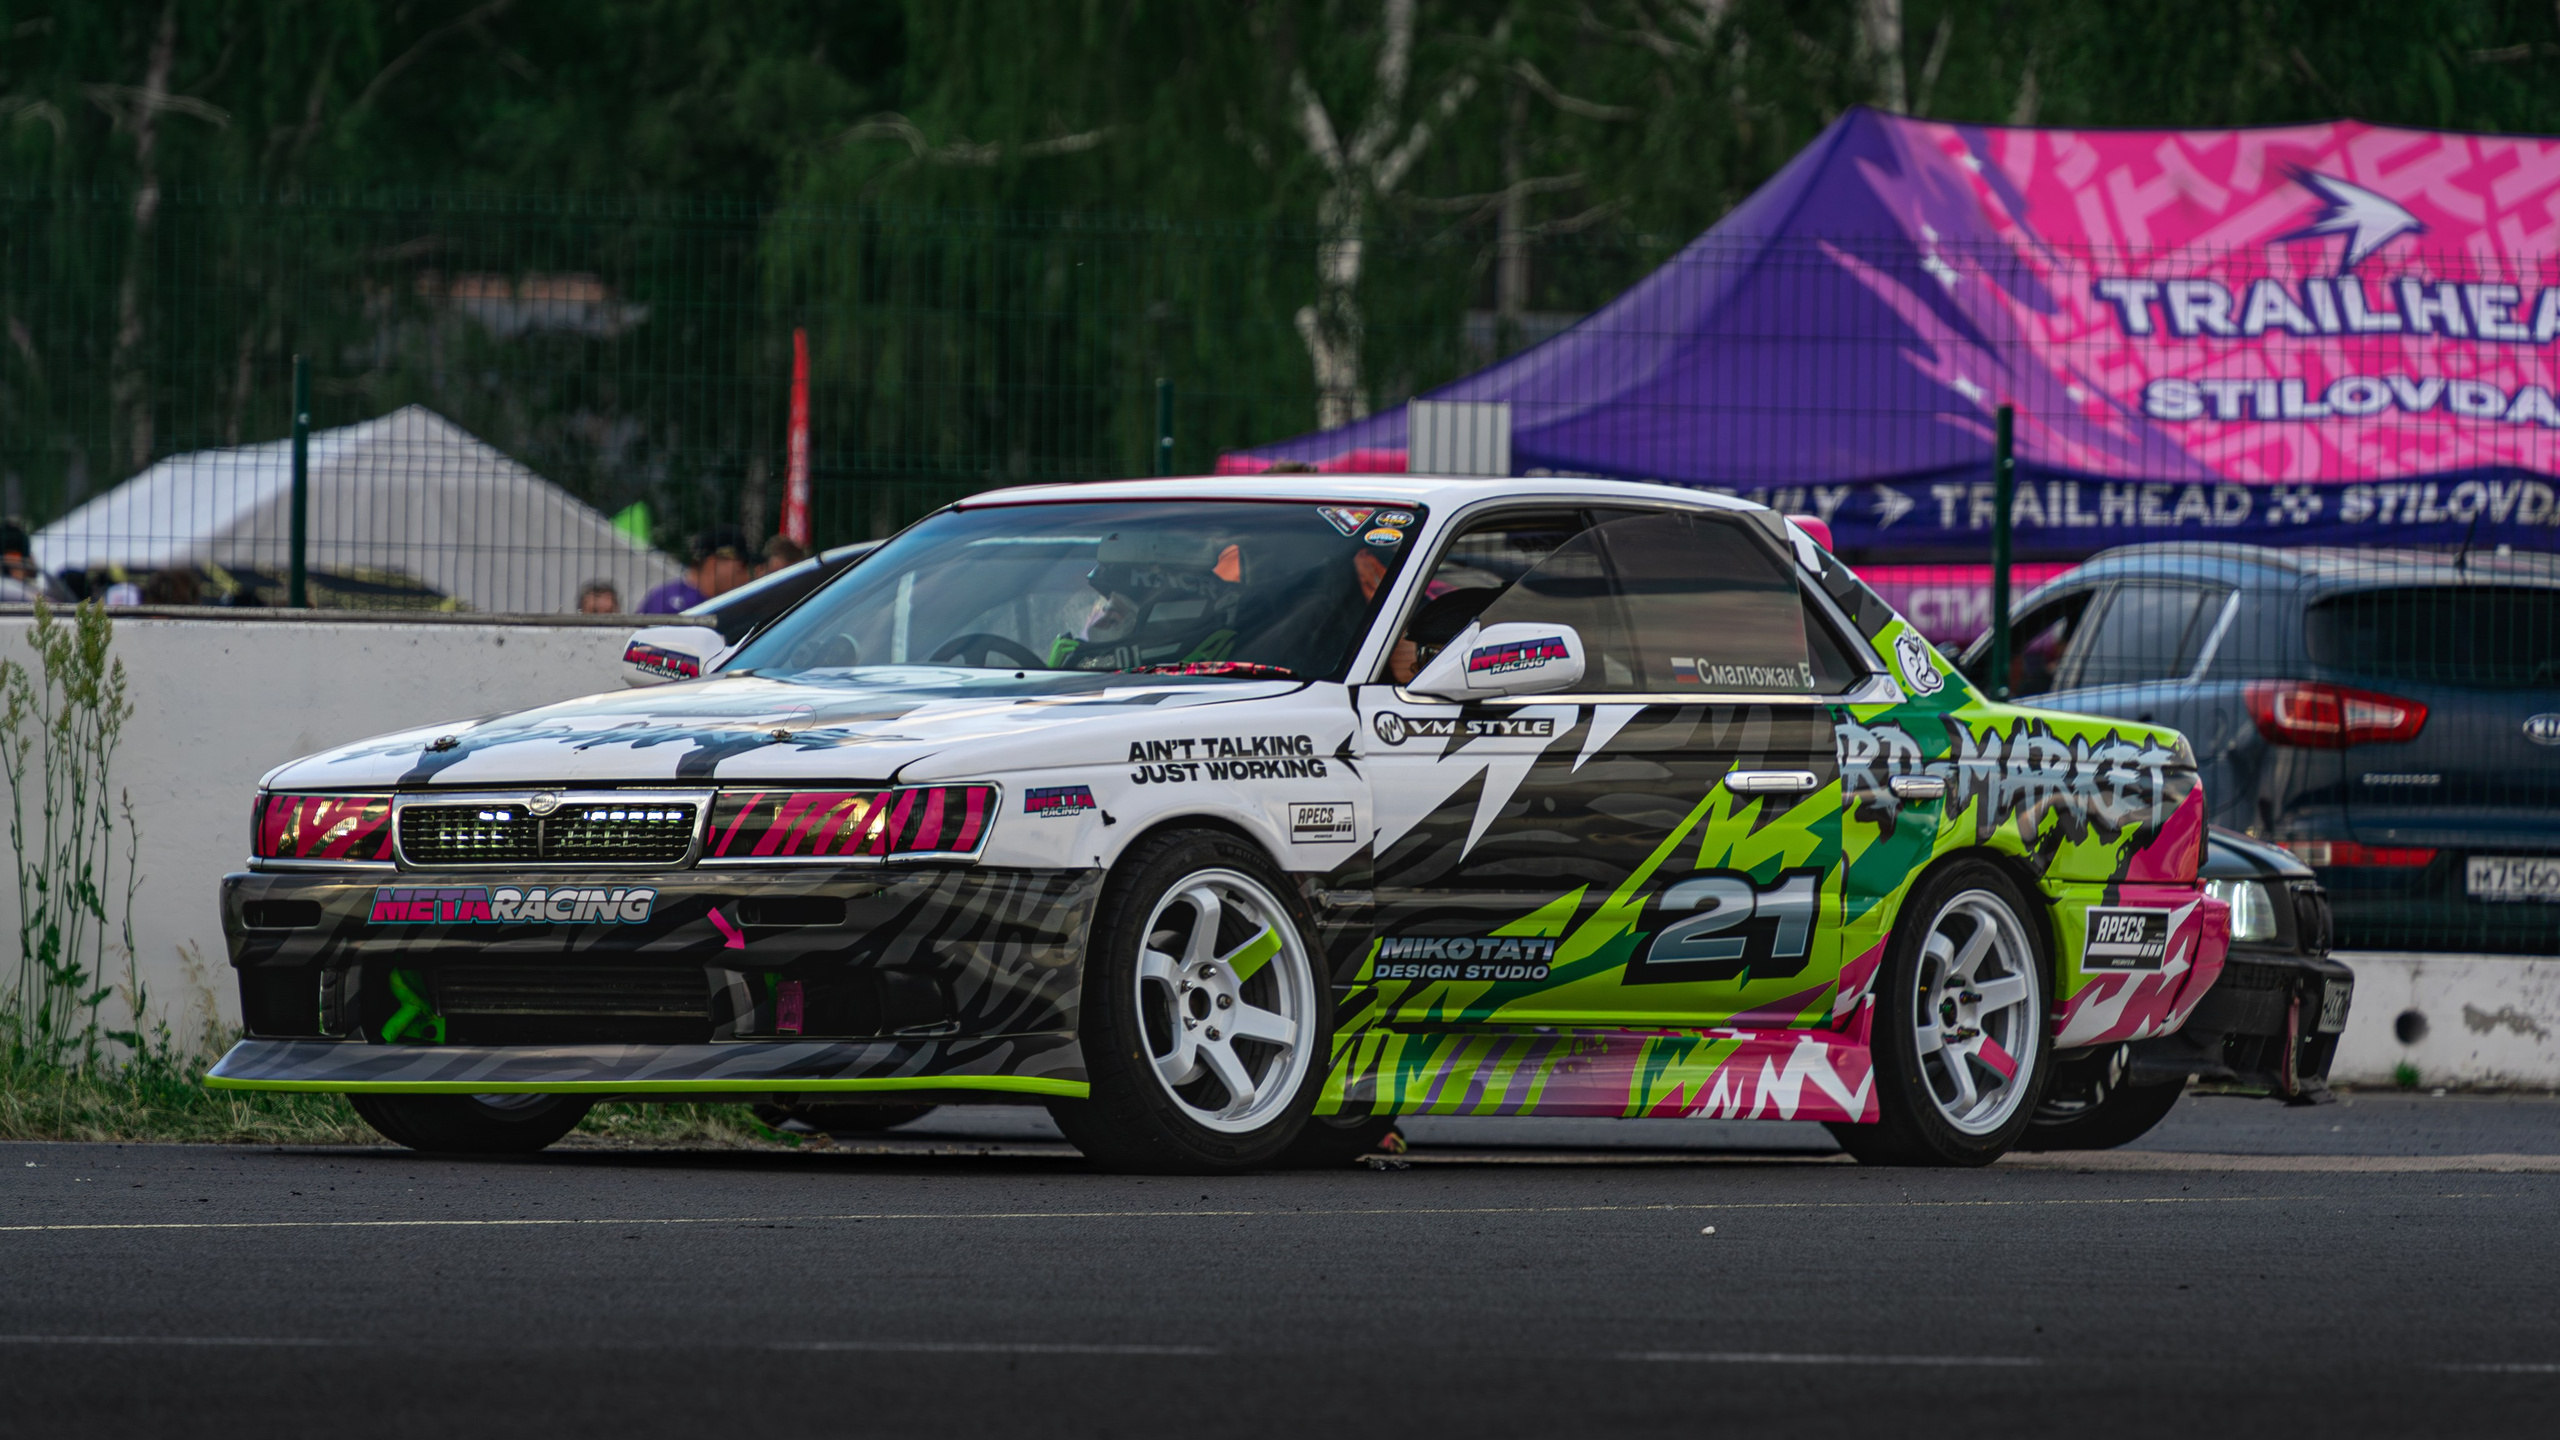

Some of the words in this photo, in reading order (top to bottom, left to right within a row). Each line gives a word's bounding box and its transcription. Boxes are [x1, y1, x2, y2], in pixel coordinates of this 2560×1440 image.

[1931, 481, 2253, 529] TRAILHEAD
[2340, 481, 2560, 526] STILOVD
[623, 641, 700, 678] META
[1468, 637, 1569, 672] META
[1491, 656, 1545, 674] RACING
[637, 661, 681, 680] RACING
[1697, 658, 1799, 687] Смалюжак
[1408, 720, 1455, 735] VM
[1466, 720, 1550, 735] STYLE
[1128, 738, 1195, 763] AIN'T
[1201, 734, 1313, 758] TALKING
[1130, 763, 1199, 785] JUST
[1204, 758, 1328, 781] WORKING
[1024, 785, 1096, 813] META
[1041, 806, 1080, 818] RACING
[1298, 807, 1334, 824] APECS
[1646, 875, 1816, 964] 21
[2095, 915, 2146, 943] APECS
[1380, 937, 1555, 960] MIKOTATI
[1374, 964, 1459, 978] DESIGN
[1465, 965, 1548, 980] STUDIO
